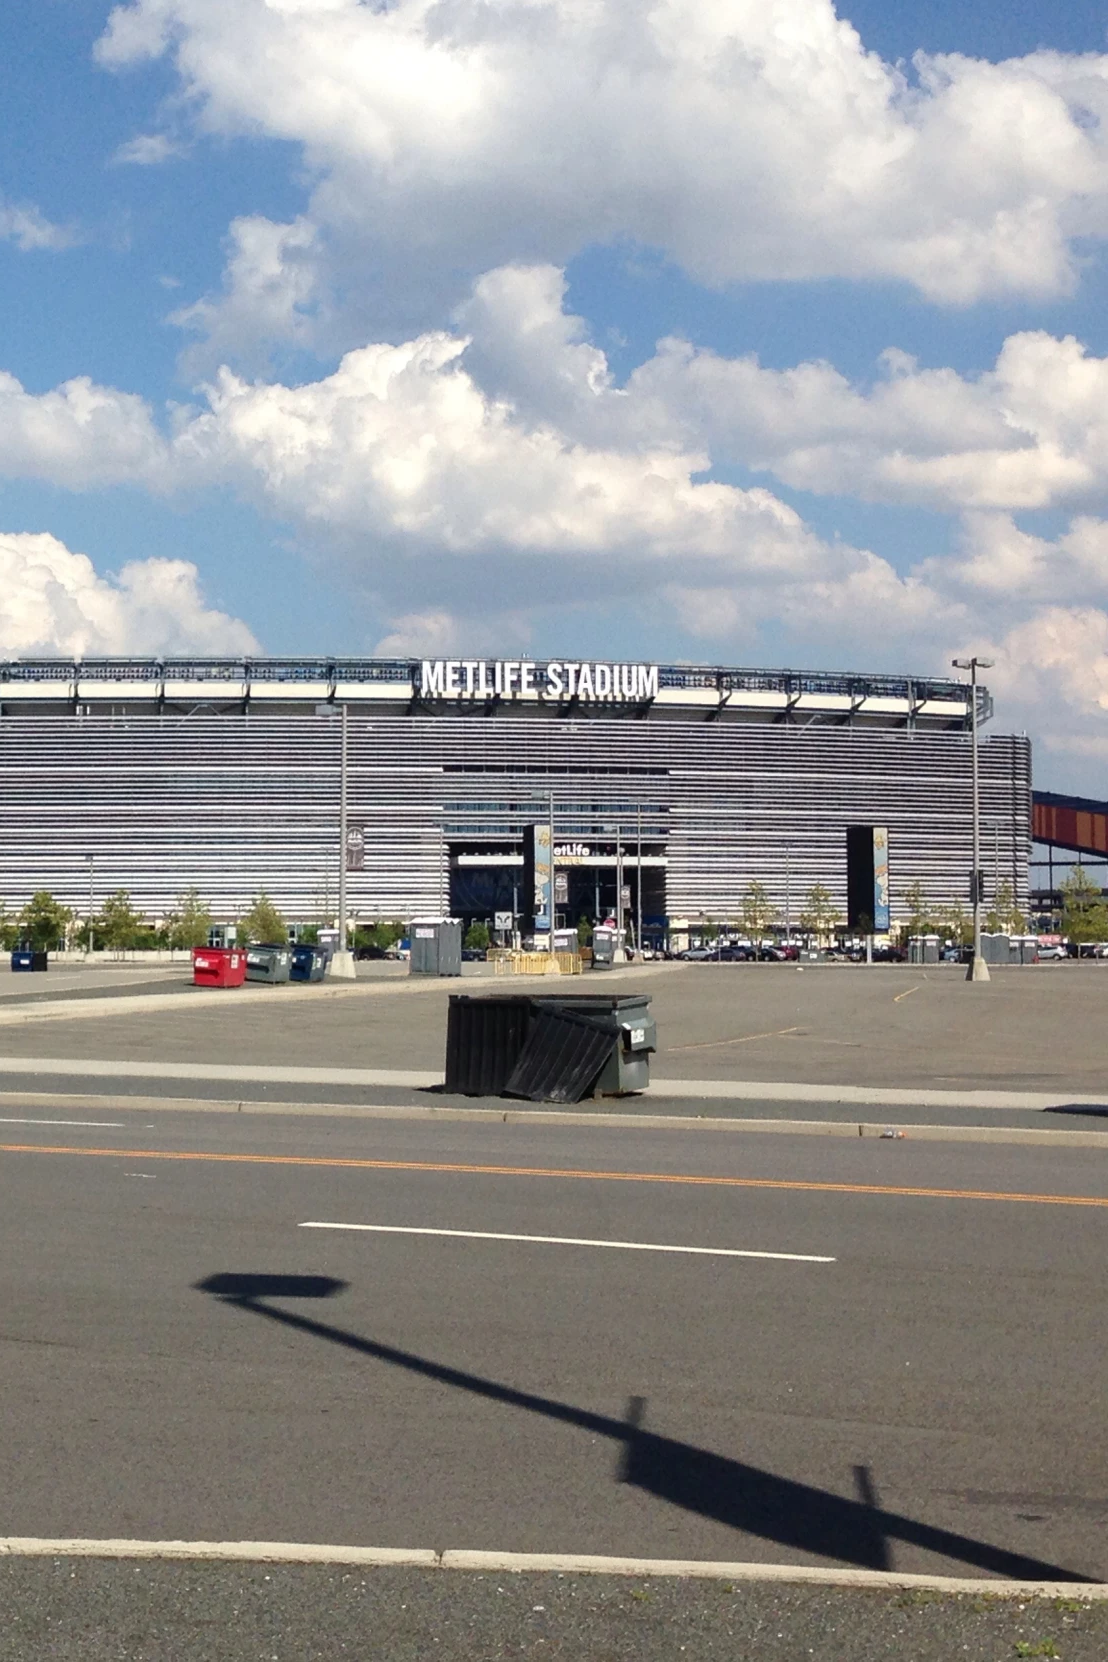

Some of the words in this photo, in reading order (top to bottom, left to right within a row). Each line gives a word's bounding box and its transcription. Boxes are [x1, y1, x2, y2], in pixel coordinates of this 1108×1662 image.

[422, 661, 535, 695] METLIFE
[545, 664, 659, 699] STADIUM
[554, 844, 590, 855] etLife
